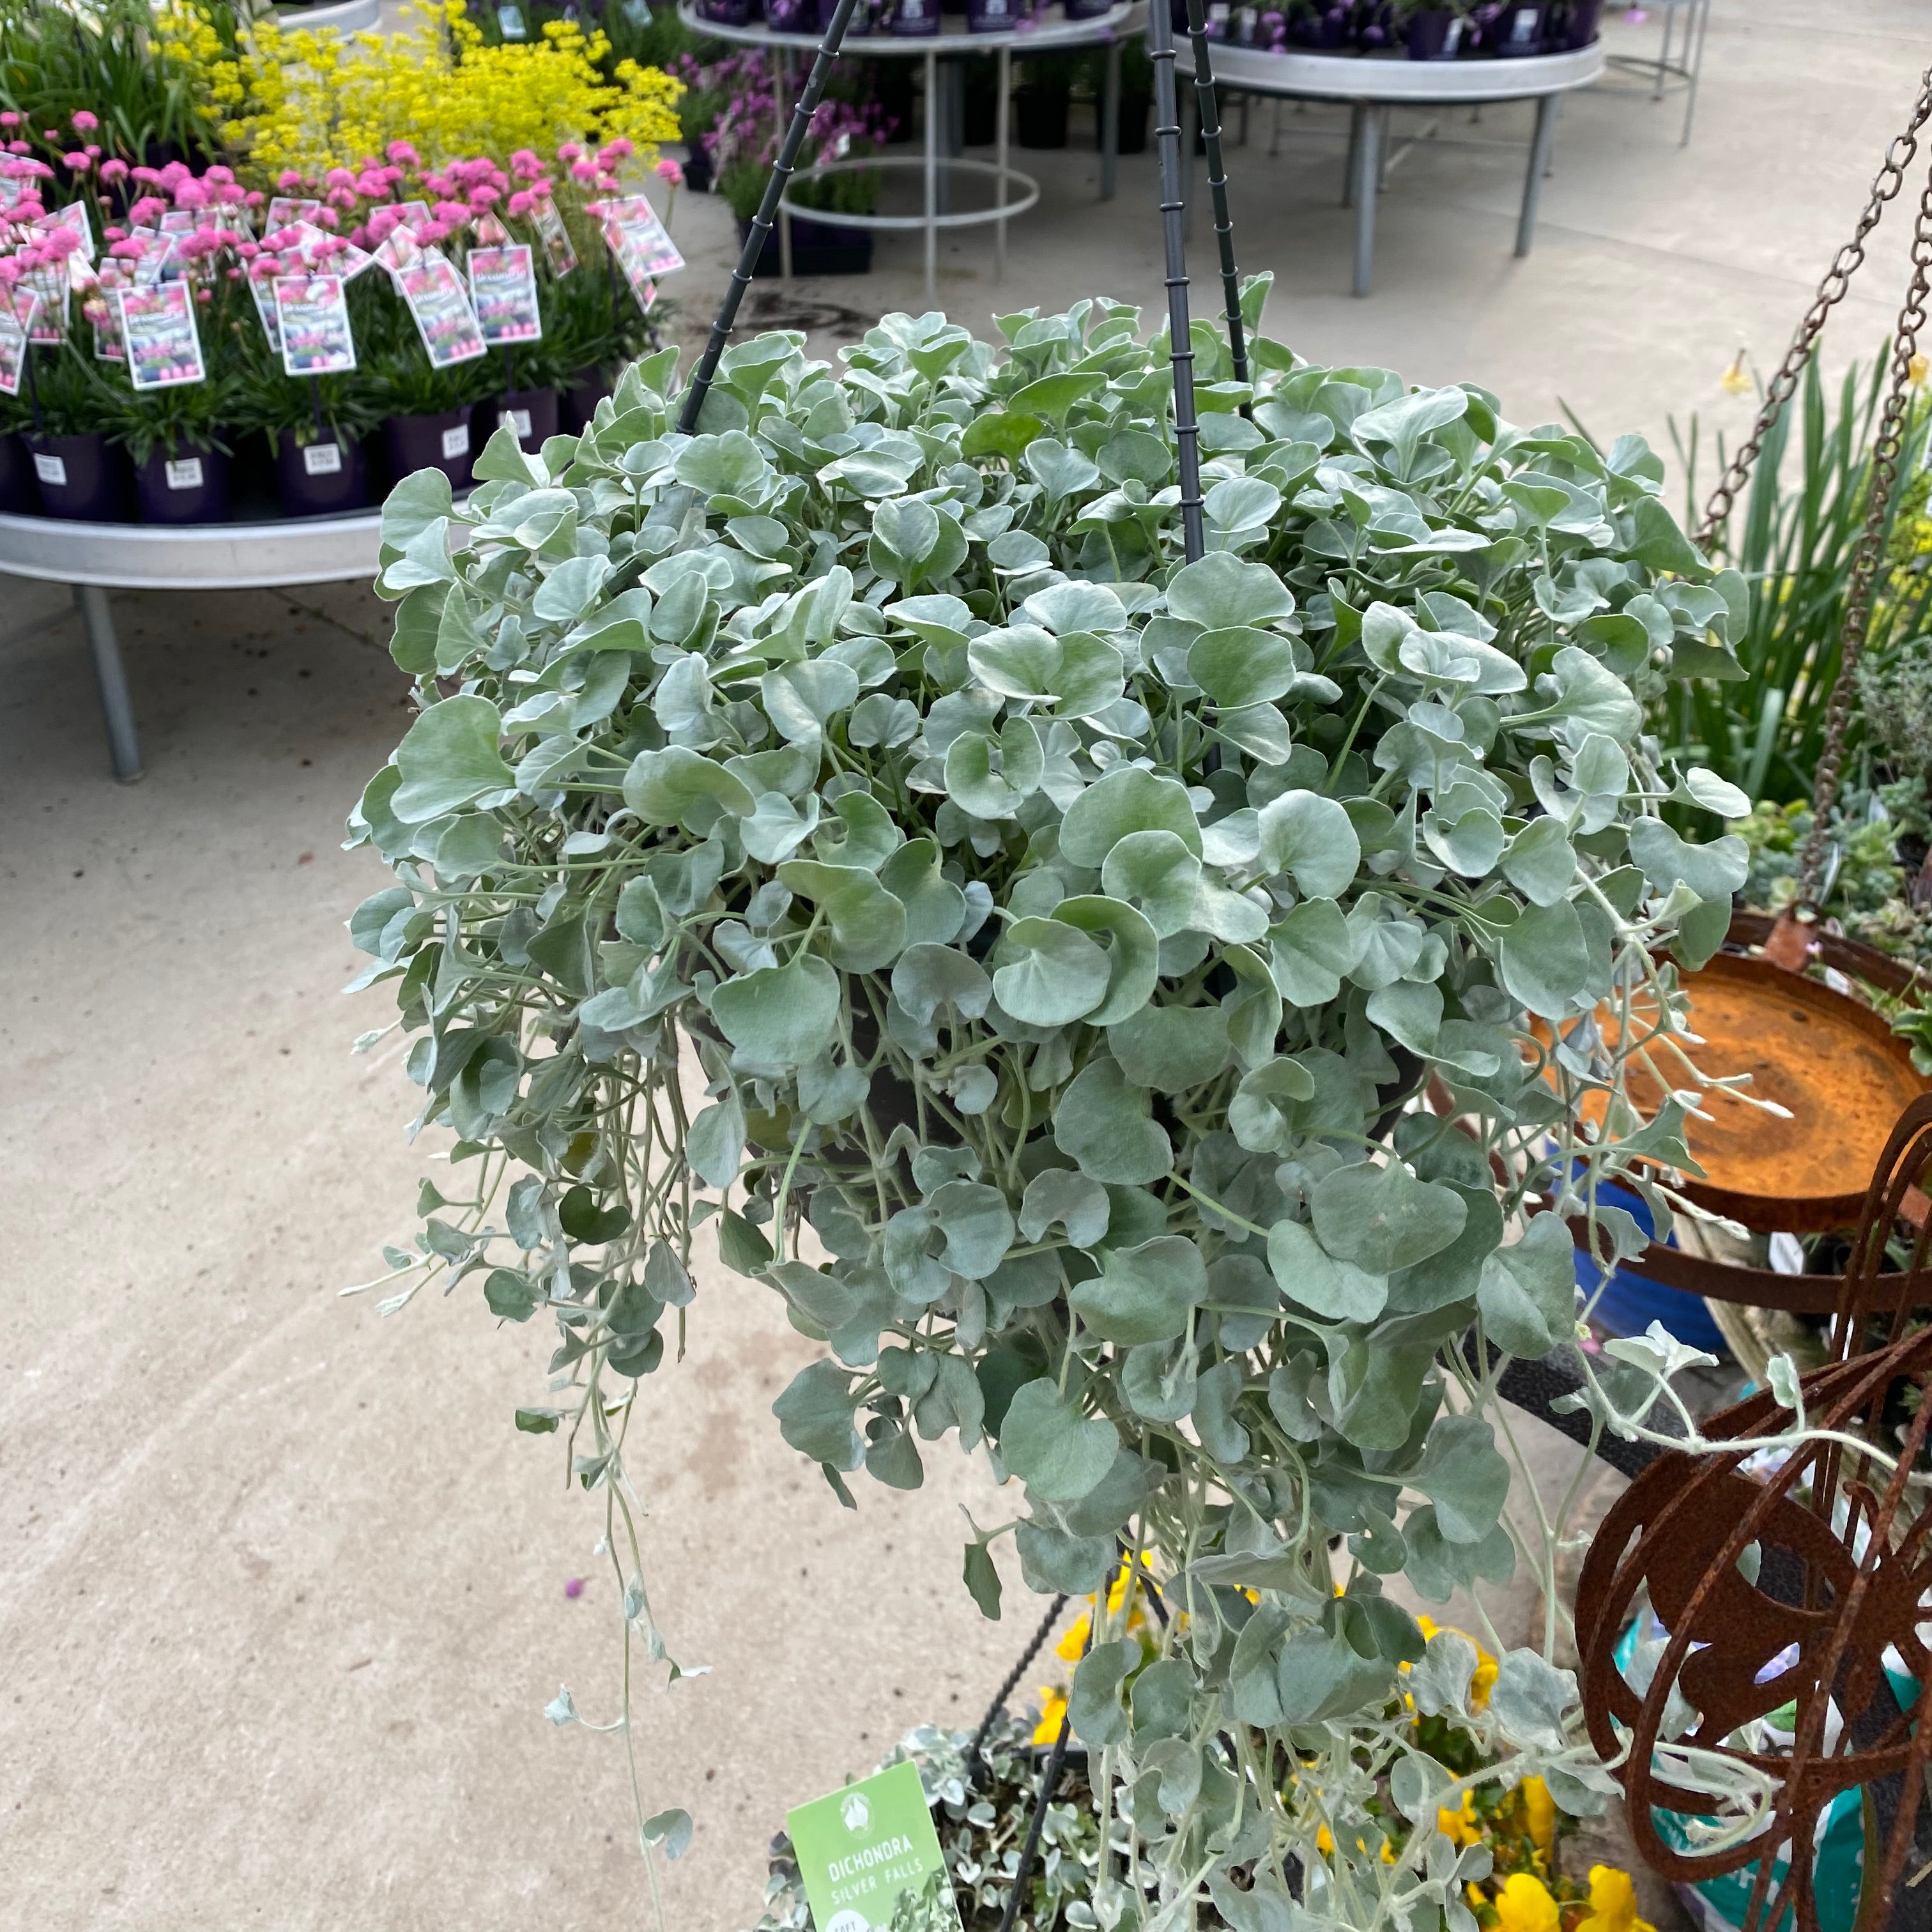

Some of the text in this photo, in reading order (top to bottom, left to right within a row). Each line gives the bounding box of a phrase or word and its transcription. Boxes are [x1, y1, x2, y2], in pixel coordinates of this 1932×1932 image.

[828, 1834, 914, 1882] DICHONDRA
[831, 1857, 924, 1905] SILVER FALLS
